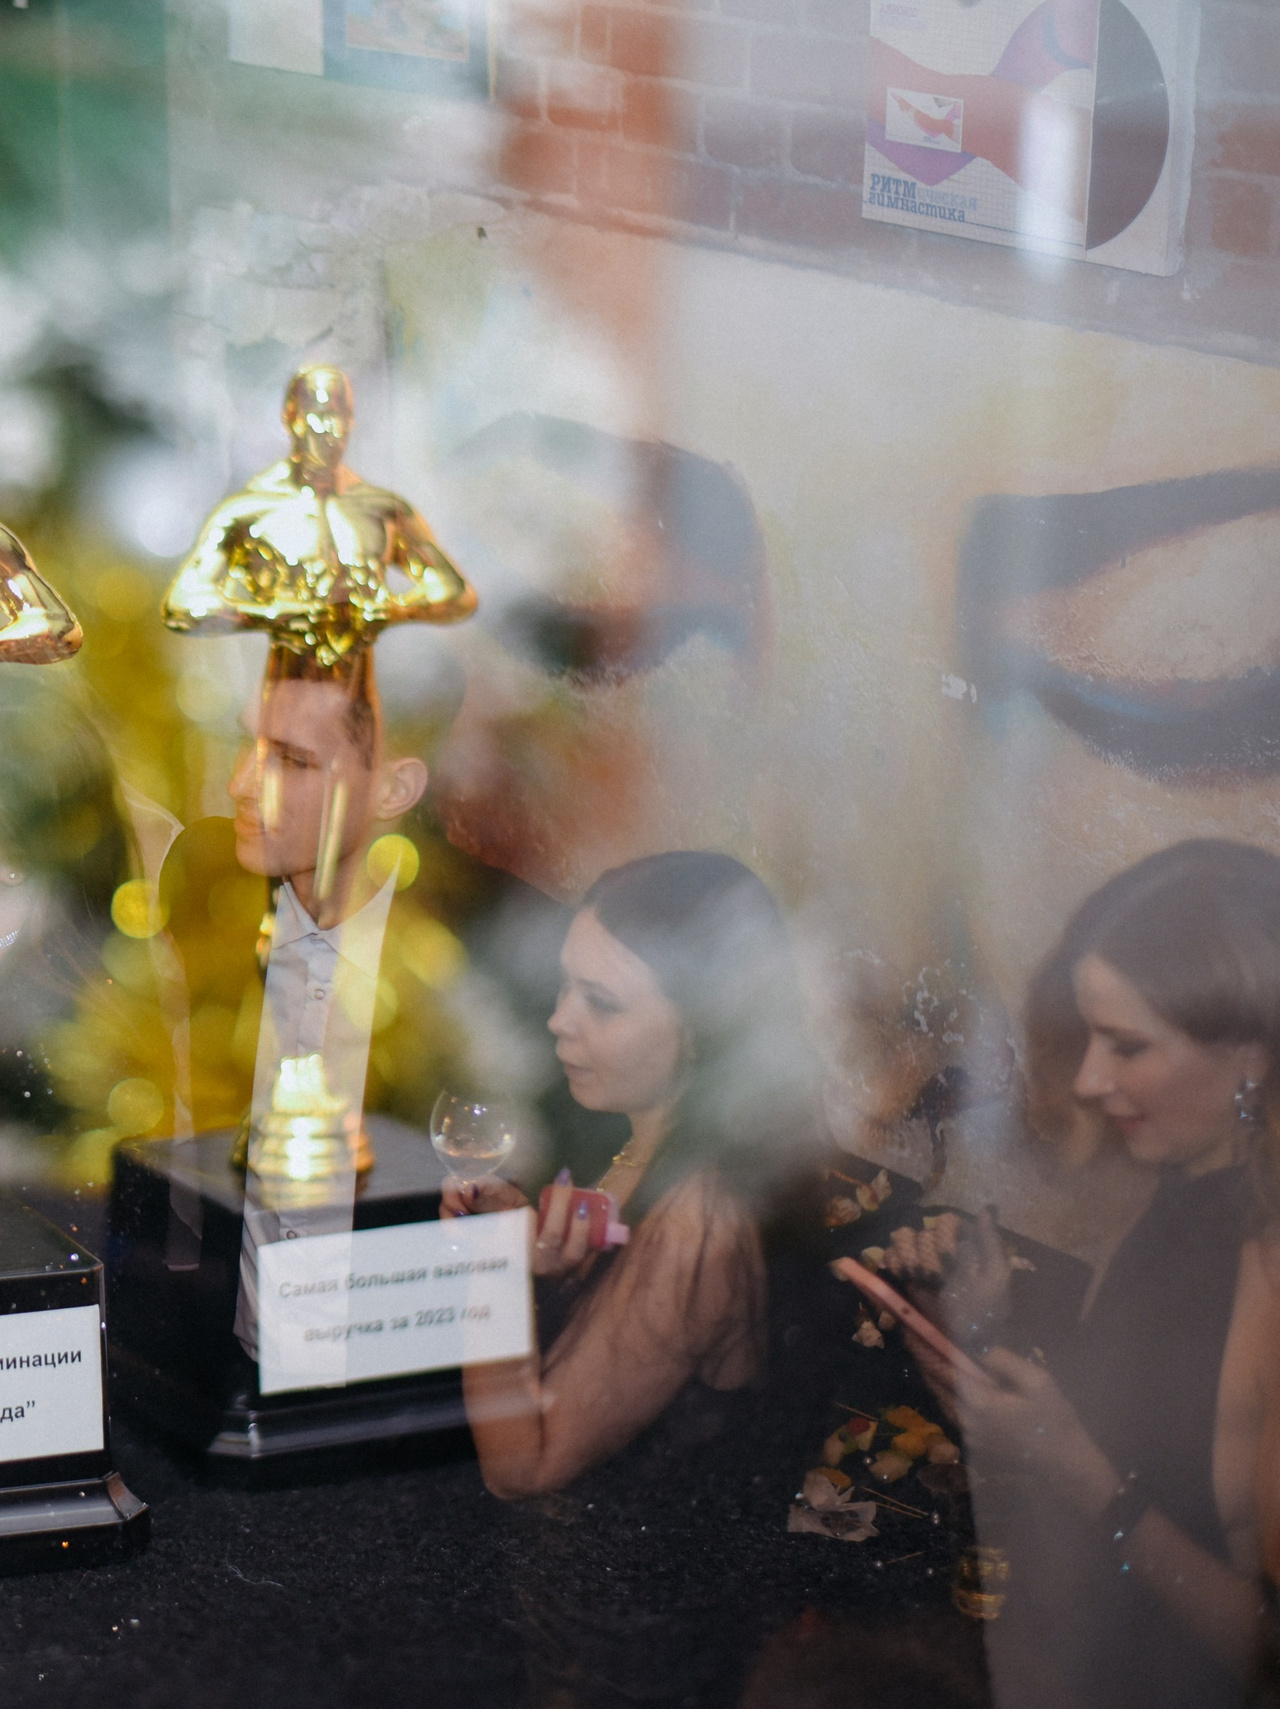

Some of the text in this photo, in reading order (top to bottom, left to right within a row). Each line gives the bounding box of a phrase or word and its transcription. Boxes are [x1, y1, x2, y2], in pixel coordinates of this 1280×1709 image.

[869, 192, 965, 222] гимнастика
[278, 1278, 339, 1299] Самая
[345, 1267, 427, 1290] большая
[303, 1303, 491, 1344] выручка за 2023 год
